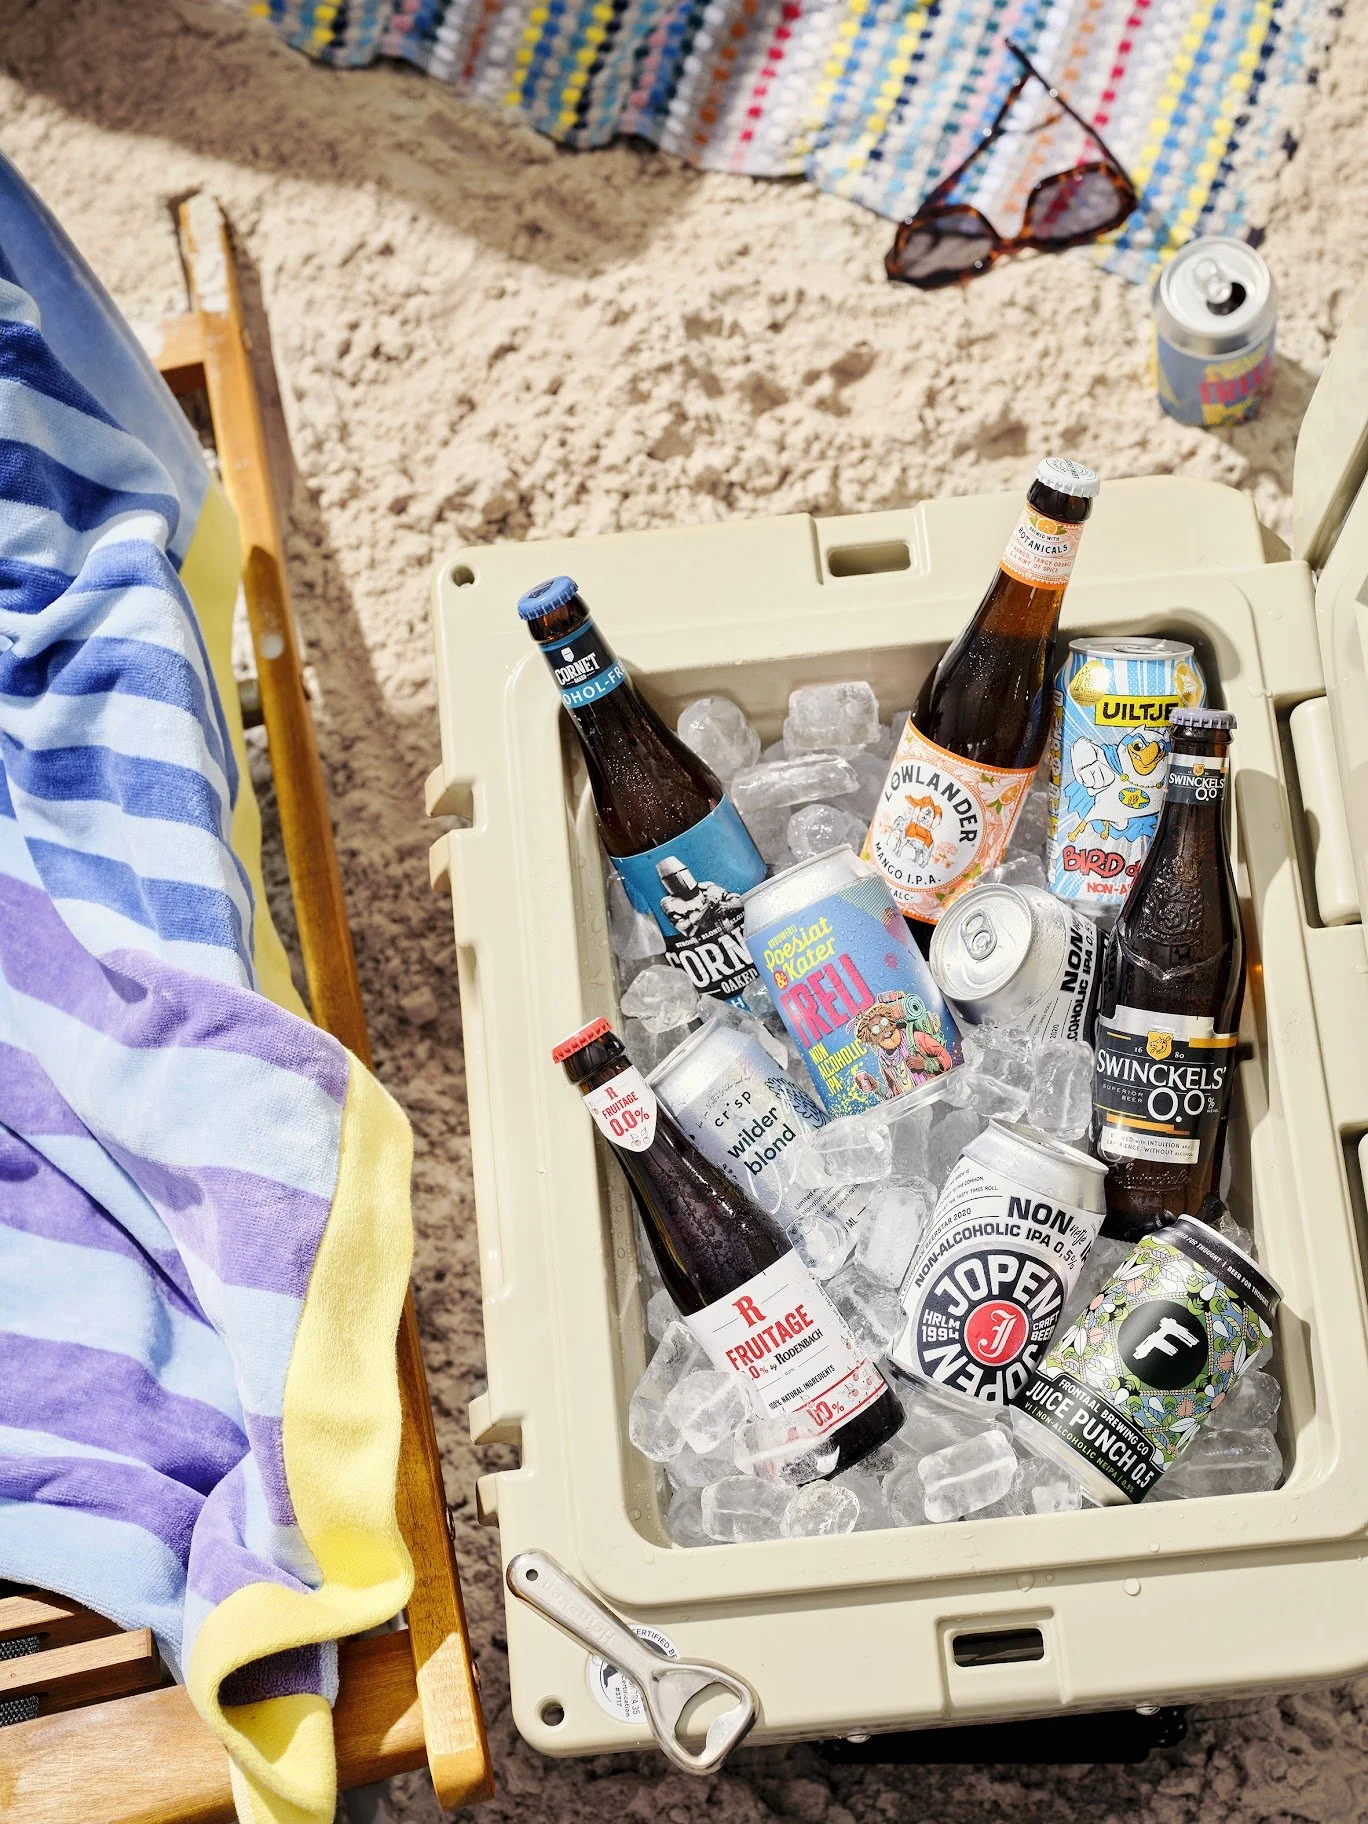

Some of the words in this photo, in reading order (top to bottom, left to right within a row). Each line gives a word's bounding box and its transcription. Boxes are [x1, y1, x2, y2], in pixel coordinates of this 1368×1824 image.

[1018, 526, 1068, 554] BOTANICALS
[554, 652, 600, 685] CORNET
[1195, 787, 1218, 802] 0.0
[875, 841, 903, 880] MANGO
[907, 873, 941, 885] I.P.A.
[1062, 845, 1126, 878] BIRD
[1087, 882, 1130, 895] NON-A
[701, 926, 722, 940] BLOND
[774, 972, 788, 989] &
[783, 936, 835, 981] Kater
[1060, 926, 1083, 994] NON
[721, 968, 759, 994] OAKED
[1066, 979, 1089, 1041] COHOLIC
[1083, 949, 1093, 975] IPA
[808, 1042, 830, 1065] NON
[818, 1039, 868, 1081] ALCOHOLIC
[1134, 1046, 1143, 1054] 16
[1174, 1051, 1185, 1059] 80
[604, 1086, 618, 1101] R
[825, 1075, 843, 1096] IPA
[1102, 1083, 1144, 1098] SUPERIOR
[1122, 1095, 1143, 1104] BEER
[602, 1091, 639, 1120] FRUITAGE
[609, 1107, 650, 1137] 0.0%
[727, 1107, 779, 1159] wilder
[744, 1123, 797, 1176] blond
[1144, 1146, 1173, 1156] WITHOUT
[1147, 1140, 1180, 1149] INTUITION
[925, 1217, 953, 1249] BEERSTAR
[953, 1207, 972, 1220] 2020
[914, 1222, 1021, 1288] NON-ALCOHOLIC
[1025, 1228, 1051, 1247] IPA
[1053, 1241, 1078, 1270] 0,5%
[1186, 1236, 1198, 1246] FOR
[1196, 1242, 1222, 1263] THOUGHT
[1226, 1265, 1242, 1280] BEER
[1241, 1277, 1251, 1290] FOR
[934, 1254, 1062, 1320] JOPEN
[731, 1295, 767, 1328] R
[923, 1309, 960, 1329] HRLM
[1032, 1311, 1058, 1331] CRAFT
[725, 1303, 814, 1371] FRUITAGE
[921, 1325, 959, 1342] 1994
[1031, 1325, 1055, 1341] BEER
[768, 1399, 783, 1410] 100%
[780, 1386, 804, 1404] NATURAL
[803, 1364, 836, 1391] INGREDIENTS
[1059, 1378, 1100, 1413] FRONTAAL
[1100, 1408, 1139, 1445] BREWING
[1136, 1442, 1149, 1455] CO
[1025, 1380, 1074, 1420] JUICE
[1068, 1408, 1138, 1473] PUNCH
[1131, 1462, 1155, 1488] 0.5
[1036, 1409, 1097, 1459] NON-ALCOHOLIC
[1096, 1457, 1119, 1479] NEIPA
